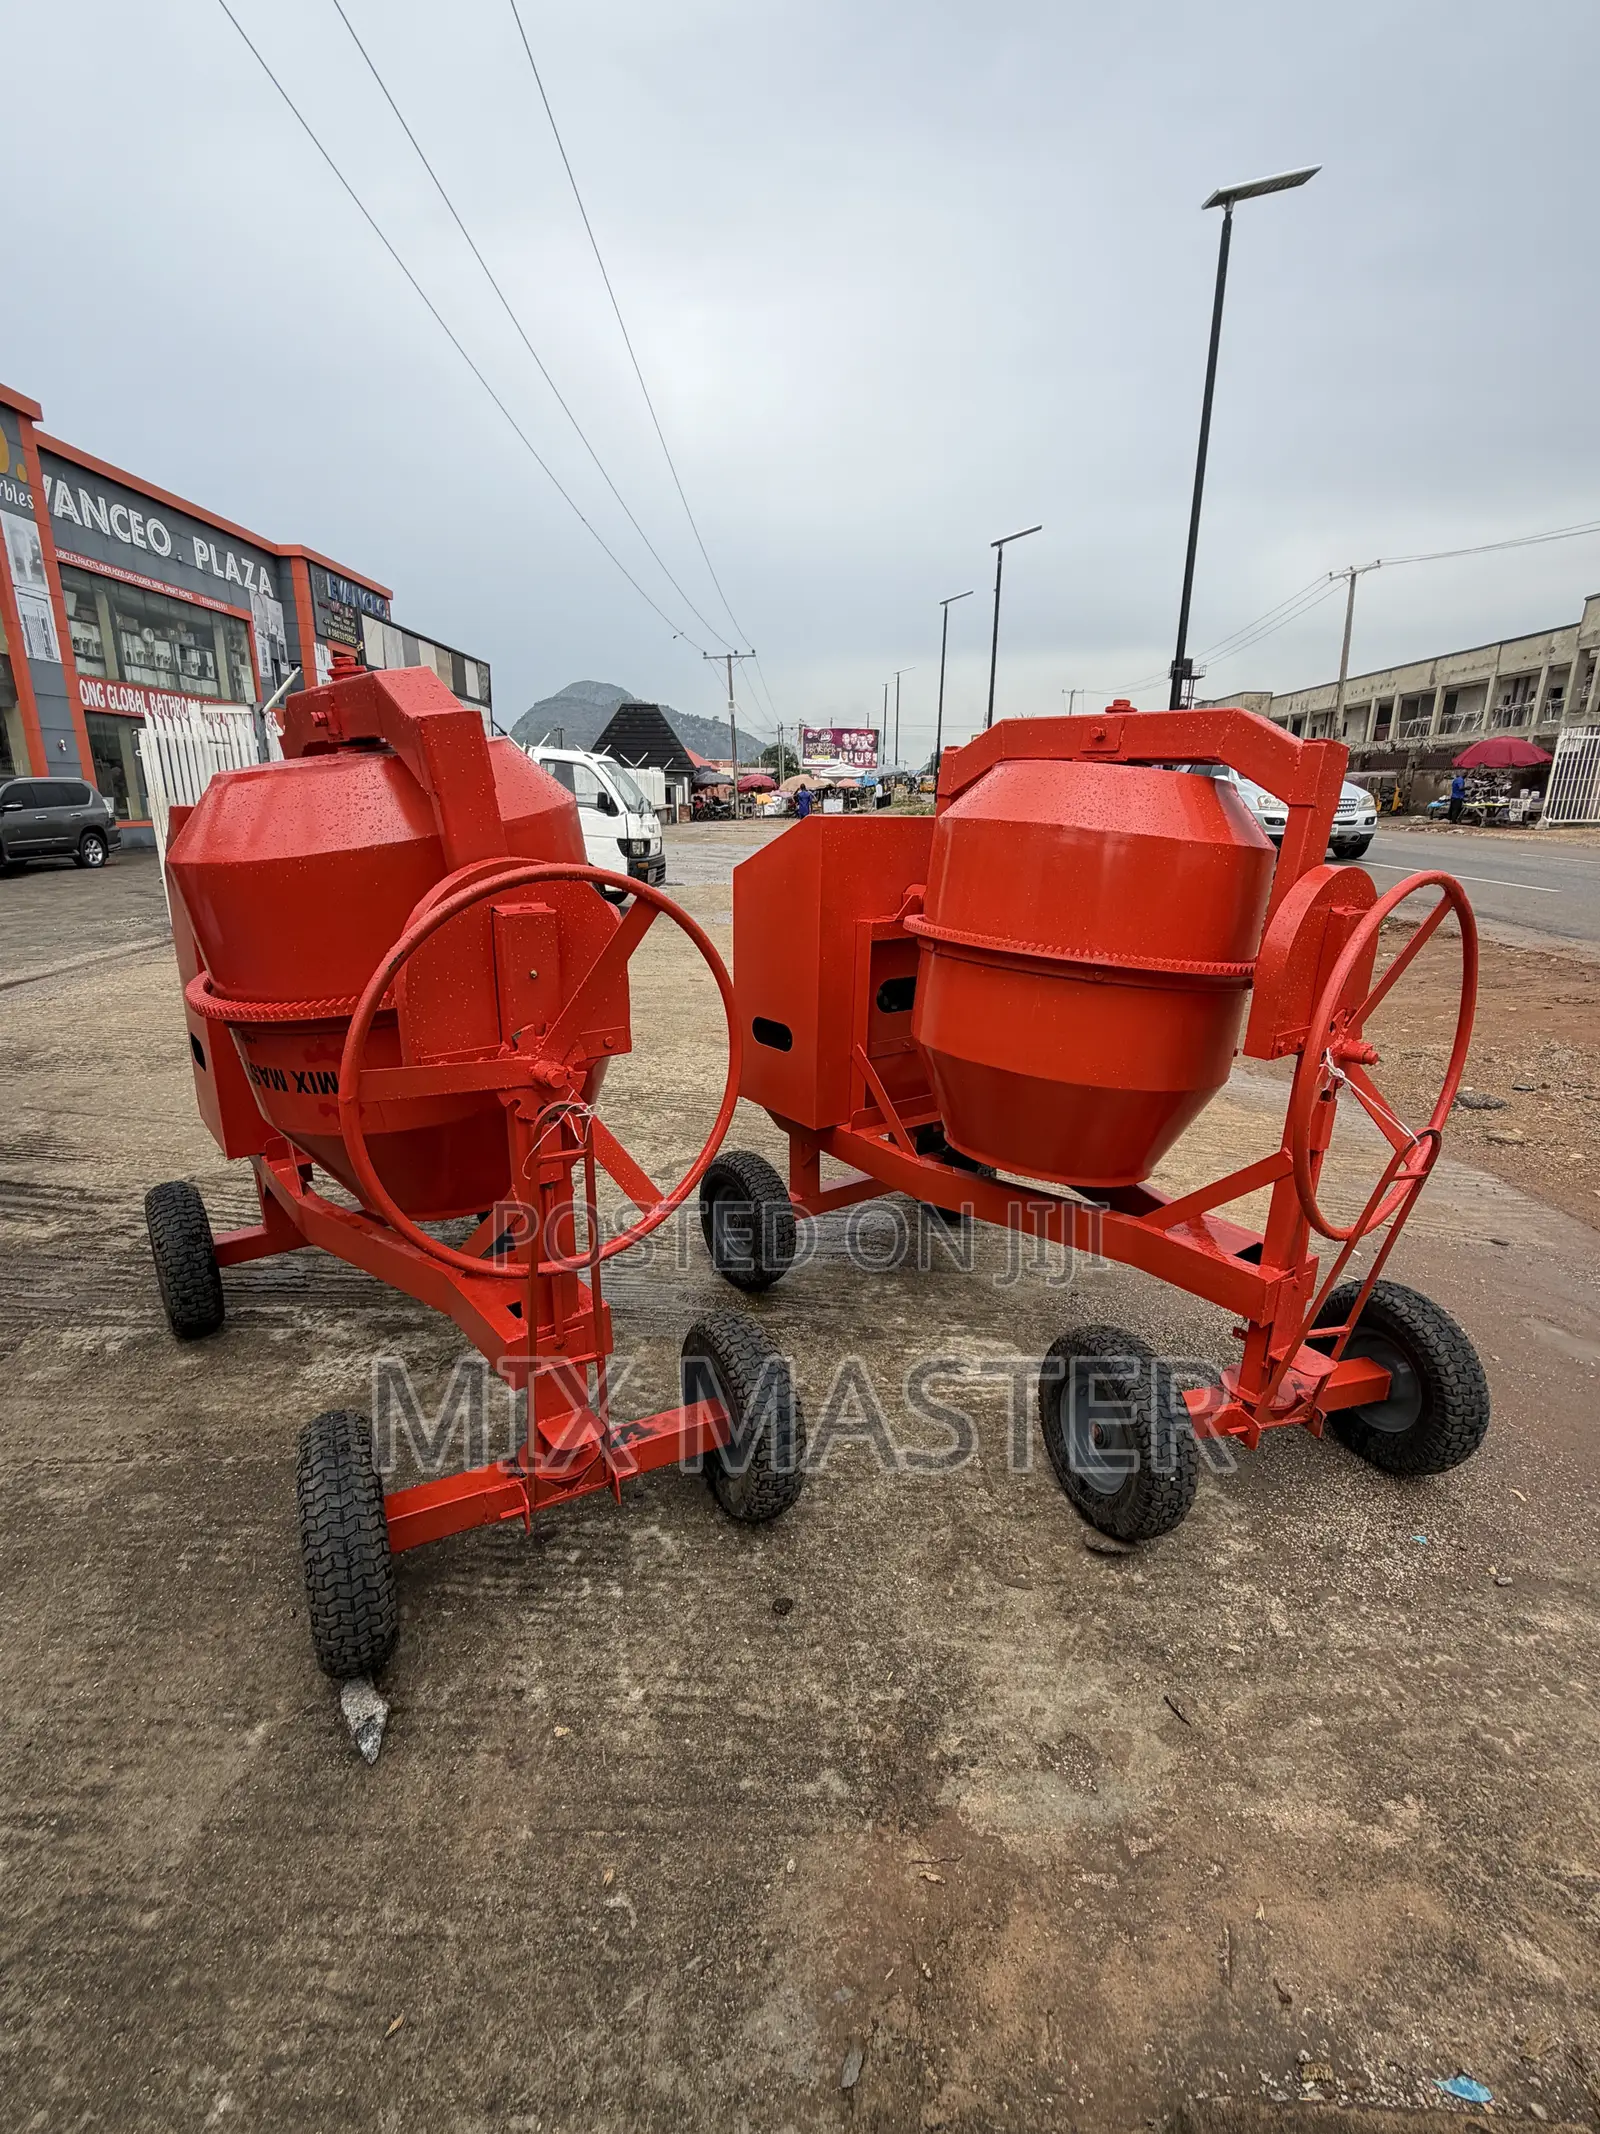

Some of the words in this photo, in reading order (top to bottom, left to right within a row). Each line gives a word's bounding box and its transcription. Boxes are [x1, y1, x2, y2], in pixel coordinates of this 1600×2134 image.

[192, 535, 274, 598] PLAZA
[78, 678, 105, 708] ONG
[107, 683, 149, 713] GLOBAL
[149, 693, 200, 719] BATHRO
[289, 1070, 340, 1095] MIX
